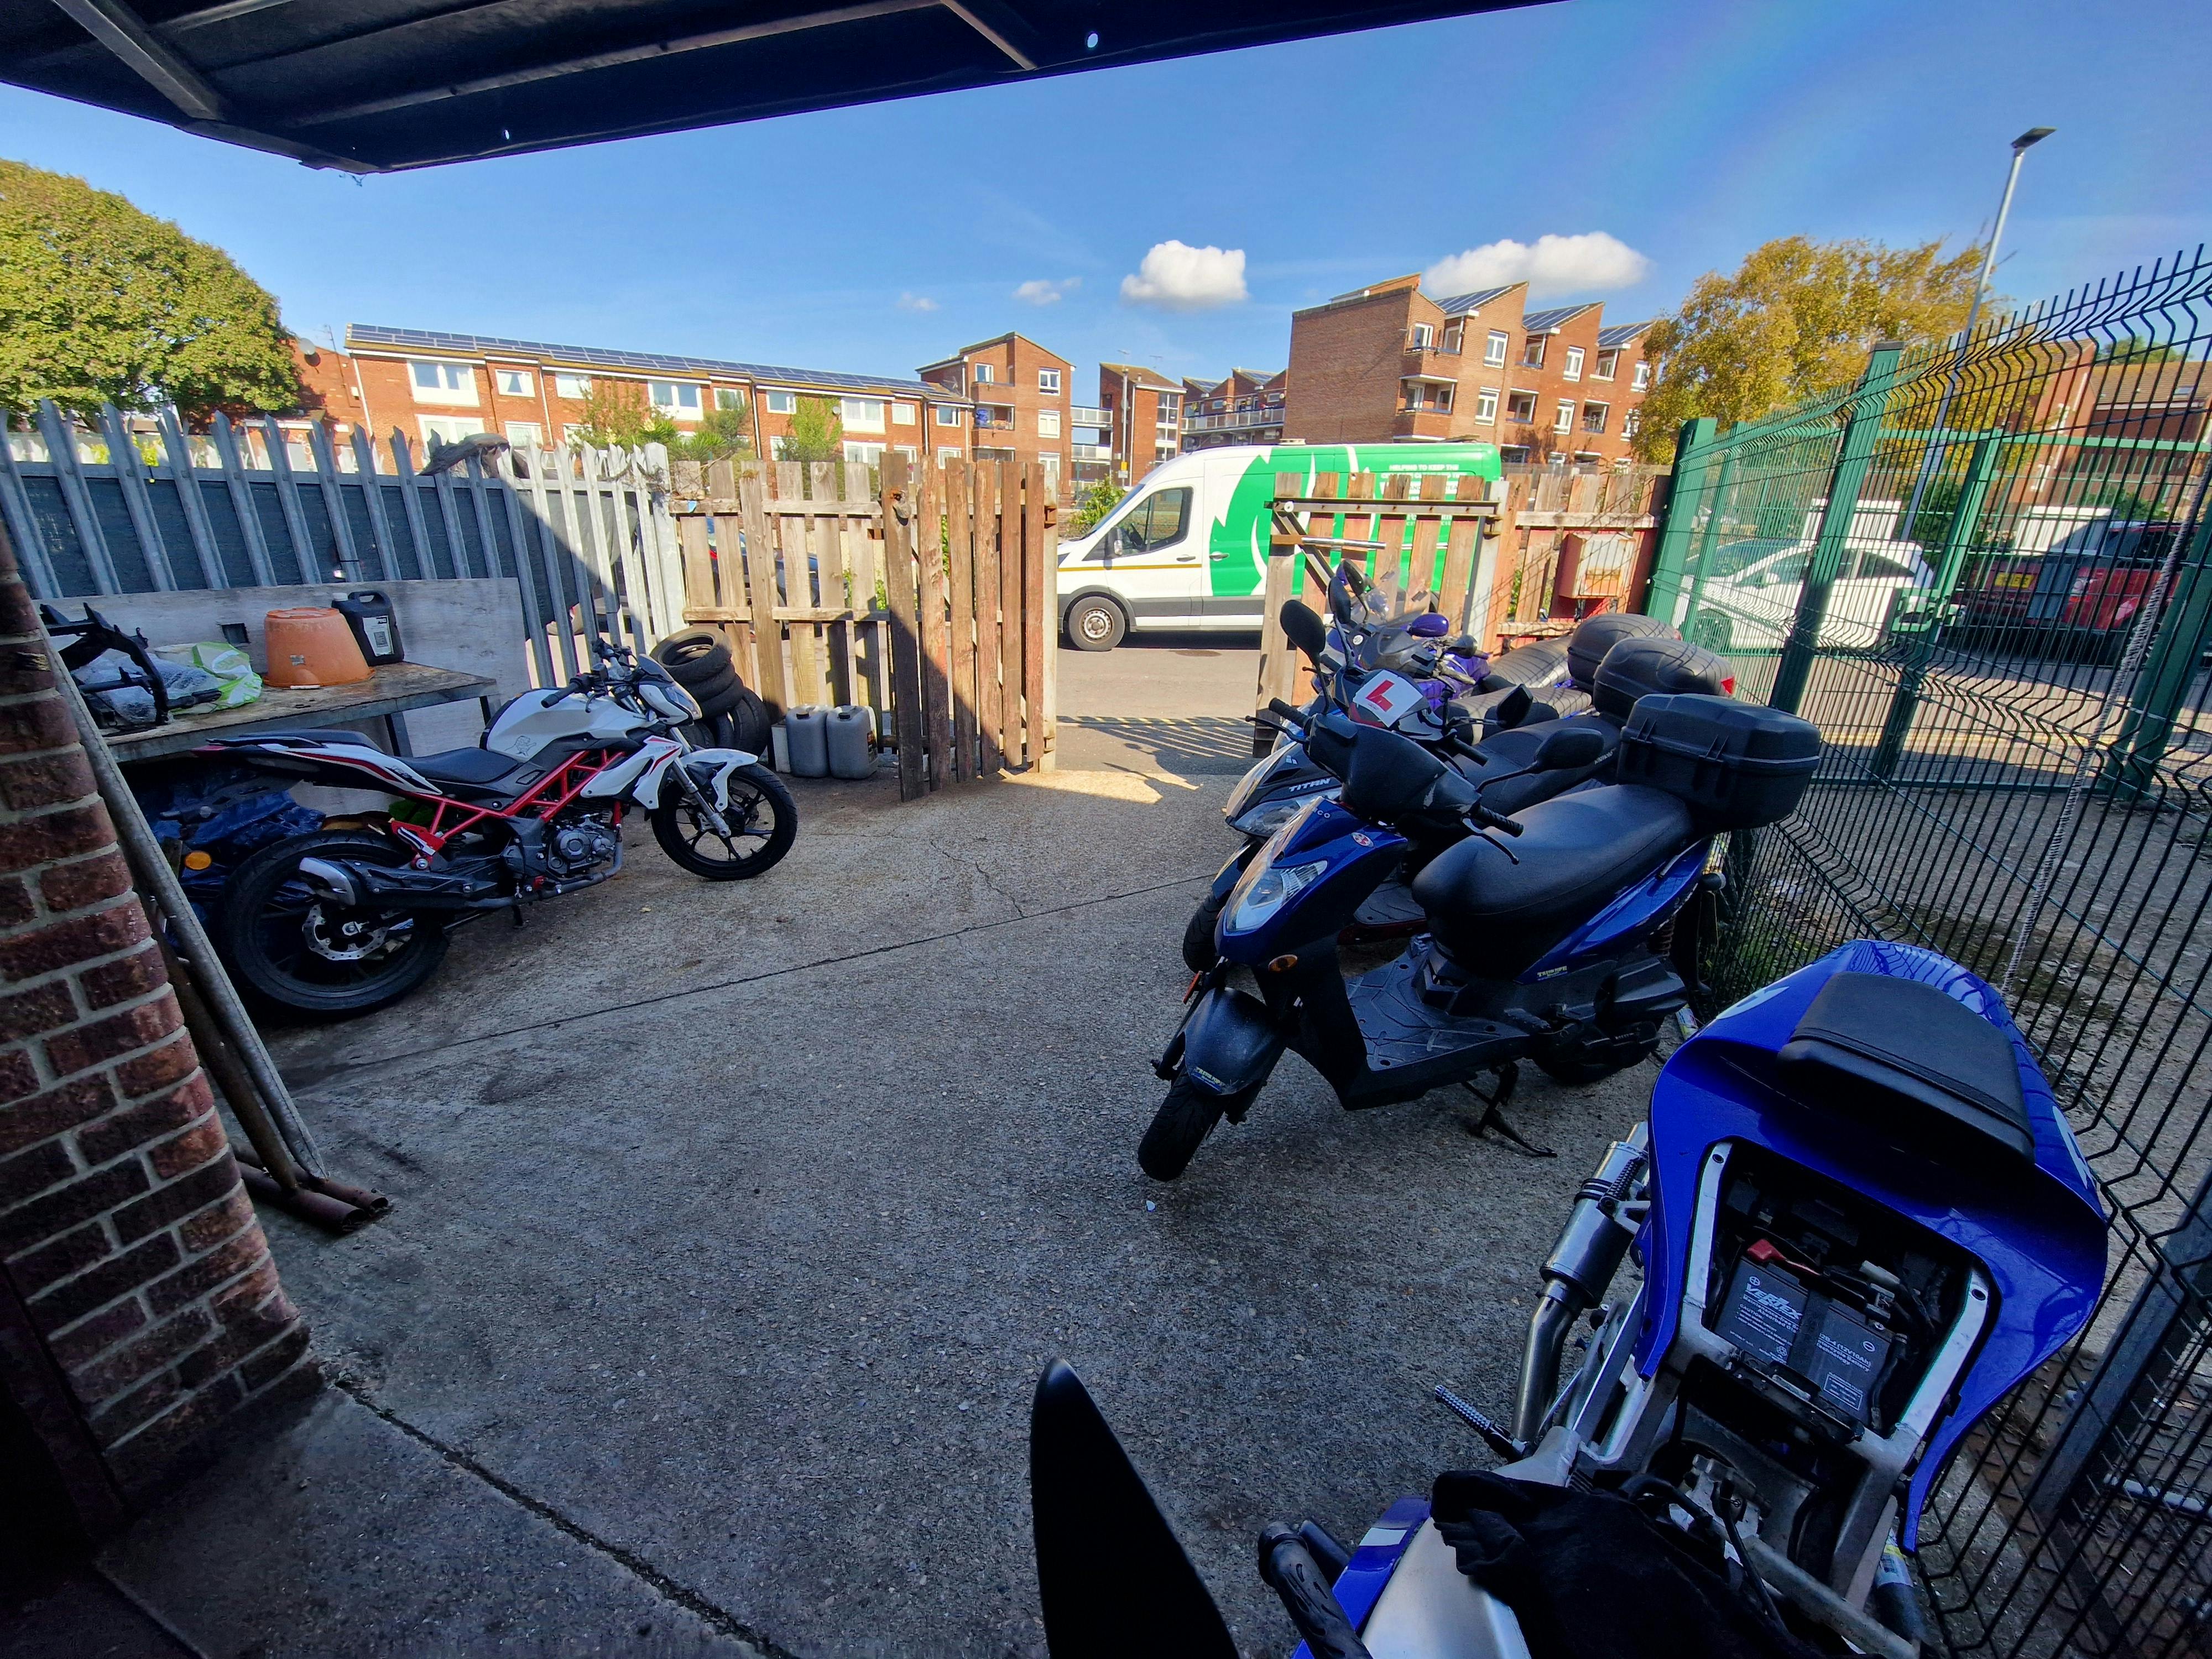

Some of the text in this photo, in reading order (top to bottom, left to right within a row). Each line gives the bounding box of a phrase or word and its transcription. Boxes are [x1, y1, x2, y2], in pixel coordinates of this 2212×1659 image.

[1365, 679, 1395, 712] L
[1288, 778, 1331, 792] TITAN
[1746, 1283, 1803, 1319] VERTEX
